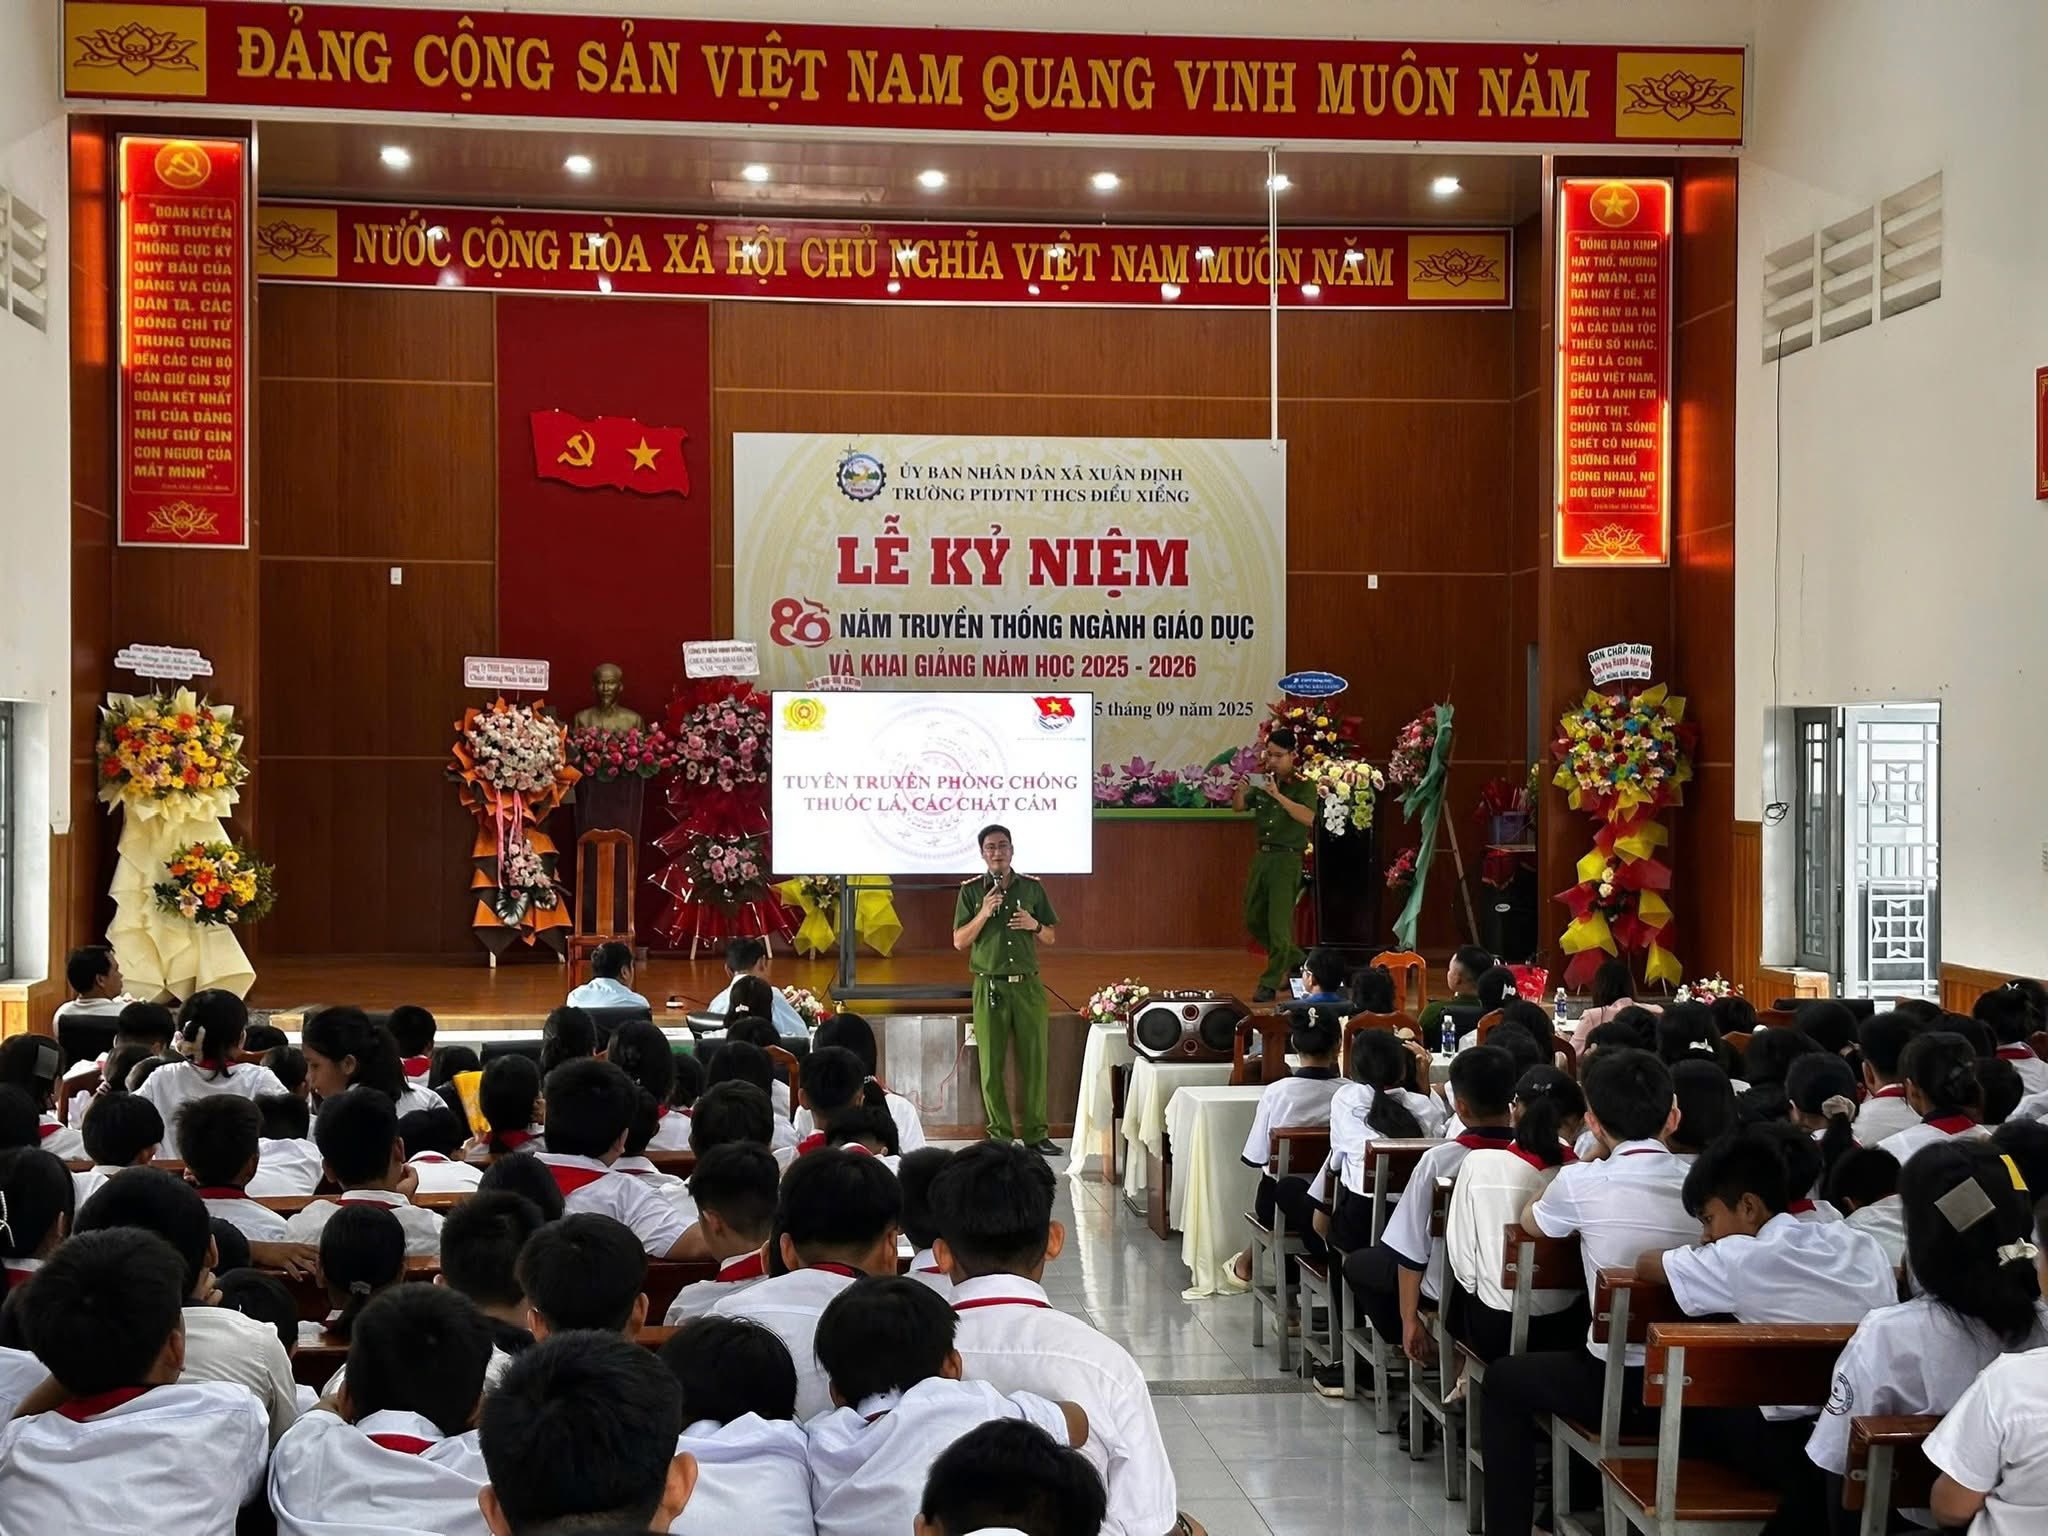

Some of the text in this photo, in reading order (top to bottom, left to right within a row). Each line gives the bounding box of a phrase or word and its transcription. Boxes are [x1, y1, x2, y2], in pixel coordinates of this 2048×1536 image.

[237, 7, 1590, 120] ĐẢNG CỘNG SẢN VIỆT NAM QUANG VINH MUÔN NĂM
[354, 209, 451, 267] NƯỚC
[462, 216, 560, 278] CỘNG
[569, 217, 651, 272] HÒA
[663, 224, 715, 274] XÃ
[726, 225, 787, 284] HỘI
[801, 224, 878, 278] CHỦ
[889, 230, 1004, 279] NGHĨA
[1011, 231, 1101, 289] VIỆT
[1112, 245, 1189, 283] NAM
[1312, 237, 1393, 285] NĂM
[1633, 239, 1657, 250] KINH
[1571, 256, 1590, 267] HAY
[1571, 272, 1593, 283] HAY
[1635, 273, 1656, 284] GIA
[1571, 289, 1588, 299] RAI
[1591, 289, 1610, 299] HAY
[1602, 306, 1621, 317] HAY
[1625, 306, 1638, 317] BA
[1642, 307, 1656, 317] NA
[134, 335, 184, 347] TRUNG
[191, 356, 212, 367] CHI
[1617, 356, 1642, 367] CON
[1613, 388, 1636, 399] ANH
[1639, 389, 1656, 399] EM
[1611, 422, 1622, 432] TA
[134, 446, 160, 458] CON
[900, 462, 1182, 484] ỦY BAN NHÂN DÂN XÃ XUÂN ĐỊNH
[1640, 472, 1655, 481] NO
[892, 484, 964, 501] TRƯỜNG
[970, 488, 1037, 501] PTDTNT
[1042, 489, 1086, 502] THCS
[1091, 482, 1131, 502] ĐIỂU
[837, 514, 1189, 598] LỄ KỶ NIỆM
[840, 608, 891, 639] NĂM
[900, 604, 983, 639] TRUYỀN
[991, 606, 1062, 639] THỐNG
[1070, 610, 1146, 639] NGÀNH
[1154, 610, 1203, 639] GIÁO
[1211, 616, 1254, 645] DỤC
[1589, 651, 1605, 663] BAN
[829, 649, 856, 676] VÀ
[861, 655, 908, 677] KHAI
[915, 647, 975, 677] GIẢNG
[983, 649, 1029, 677] NĂM
[1036, 655, 1075, 681] HỌC
[1082, 655, 1129, 677] 2025
[1150, 655, 1196, 677] 2026
[1108, 701, 1152, 719] tháng
[1156, 702, 1174, 716] 09
[1179, 702, 1212, 716] năm
[1218, 702, 1253, 716] 2025
[938, 772, 1004, 789] PHÒNG
[912, 794, 952, 811] CÁC
